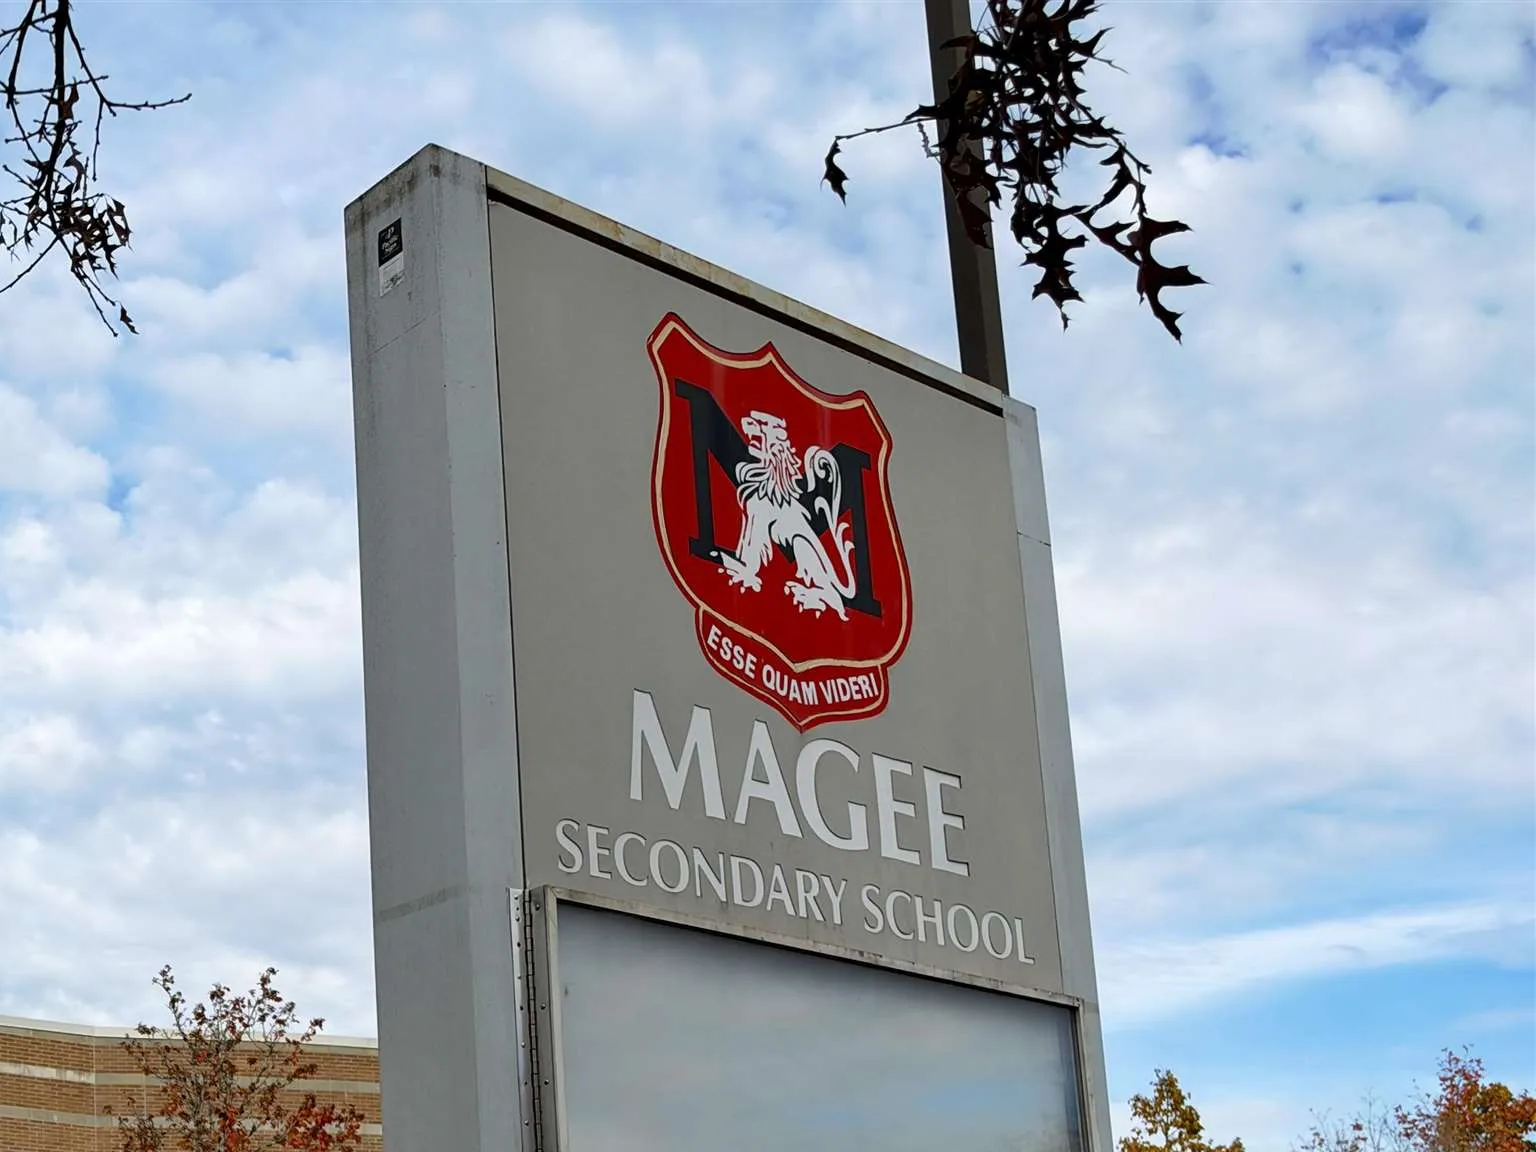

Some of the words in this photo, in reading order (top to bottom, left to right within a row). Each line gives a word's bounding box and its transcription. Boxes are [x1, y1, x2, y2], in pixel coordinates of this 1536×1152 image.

[706, 624, 757, 679] ESSE
[762, 664, 819, 706] QUAM
[819, 672, 879, 705] VIDERI
[628, 688, 971, 877] MAGEE
[554, 817, 848, 927] SECONDARY
[860, 883, 1036, 966] SCHOOL
